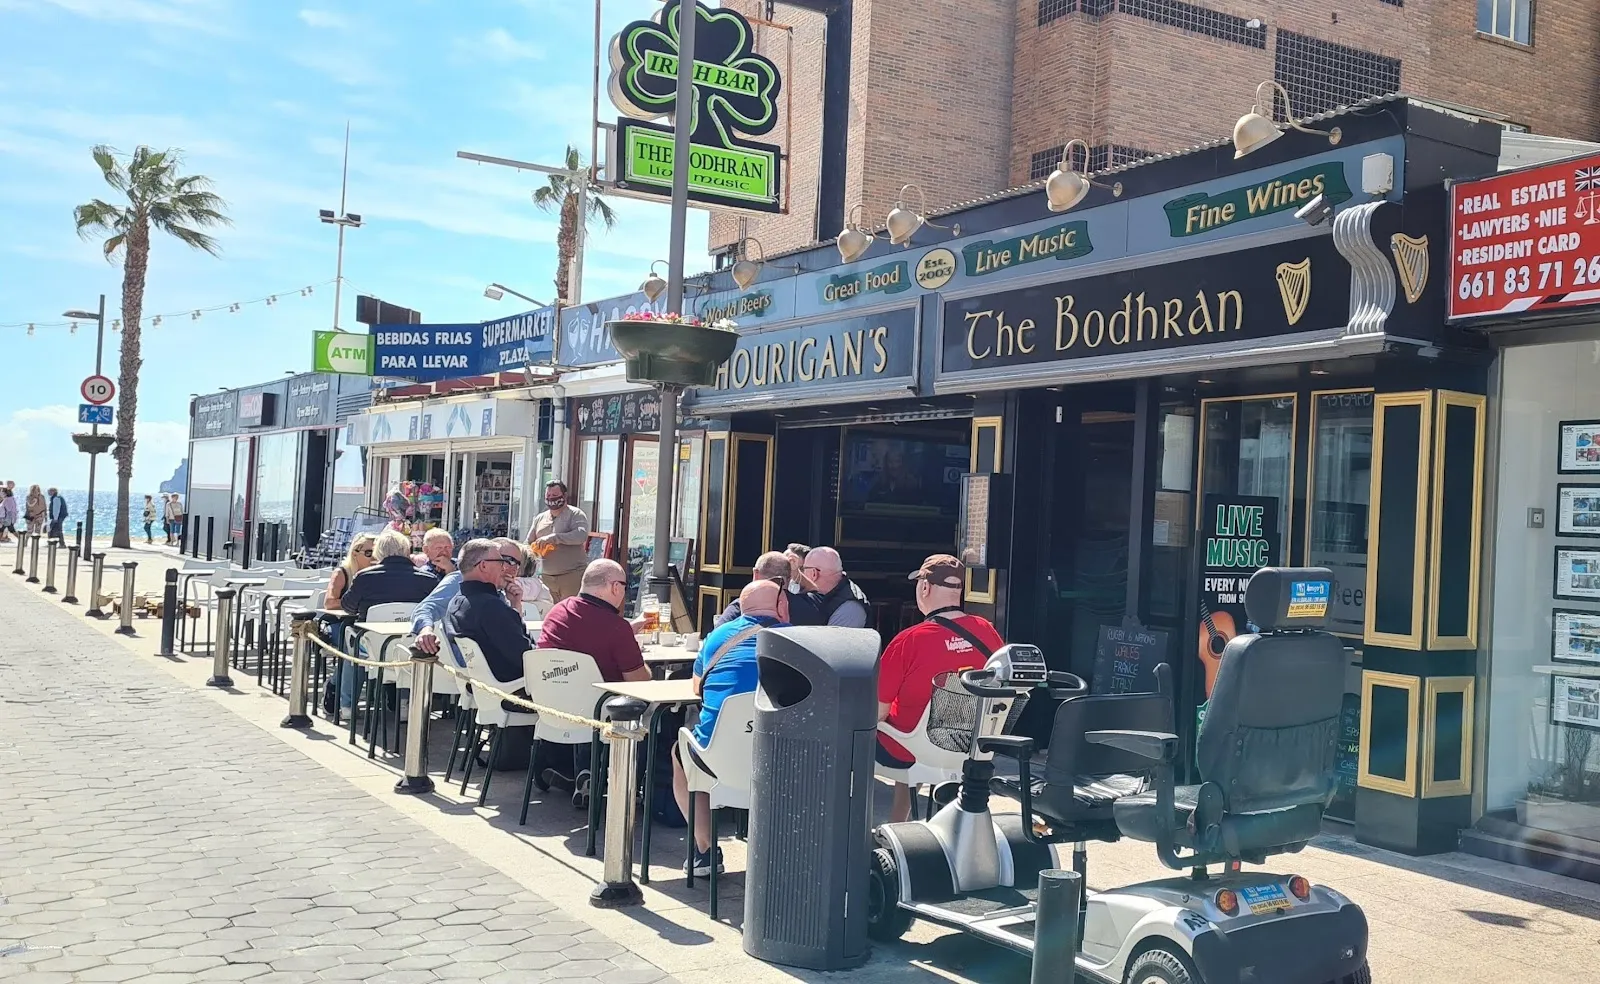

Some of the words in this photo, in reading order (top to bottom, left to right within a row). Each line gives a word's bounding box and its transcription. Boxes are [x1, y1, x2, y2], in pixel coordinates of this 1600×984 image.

[650, 55, 712, 83] IRH
[715, 70, 755, 92] BAR
[636, 142, 672, 164] THE
[689, 151, 763, 180] ODHRÁN
[649, 164, 673, 177] Liv
[1185, 202, 1236, 234] Fine
[1246, 173, 1325, 215] Wines
[1511, 179, 1566, 207] ESTATE
[975, 246, 1012, 274] Live
[1018, 227, 1077, 262] Music
[1537, 231, 1581, 255] CARD
[918, 266, 953, 282] 2003
[923, 258, 947, 270] Est.
[823, 279, 861, 302] Great
[865, 265, 900, 290] Food
[1458, 270, 1495, 300] 661
[1503, 265, 1530, 295] 83
[1538, 260, 1563, 290] 71
[1572, 255, 1600, 286] 26
[705, 301, 739, 323] World
[740, 294, 773, 314] Beers
[376, 332, 430, 346] BEBIDAS
[435, 331, 473, 345] FRIAS
[481, 310, 552, 349] SUPERMARKET
[964, 309, 1036, 360] The
[331, 346, 366, 360] ATM
[381, 355, 417, 369] PARA
[422, 355, 468, 368] LLEVAR
[499, 346, 530, 366] PLAYA
[714, 326, 889, 391] HOURIGAN'S
[89, 384, 106, 395] 10
[1216, 504, 1264, 537] LIVE
[1206, 538, 1269, 568] MUSIC
[1204, 577, 1236, 592] EVERY
[1217, 593, 1237, 604] FROM
[1106, 628, 1126, 641] RUGBY
[1128, 633, 1133, 642] 6
[1115, 646, 1140, 660] WALES
[1113, 660, 1139, 675] FRANCE
[1110, 676, 1134, 690] ITALY
